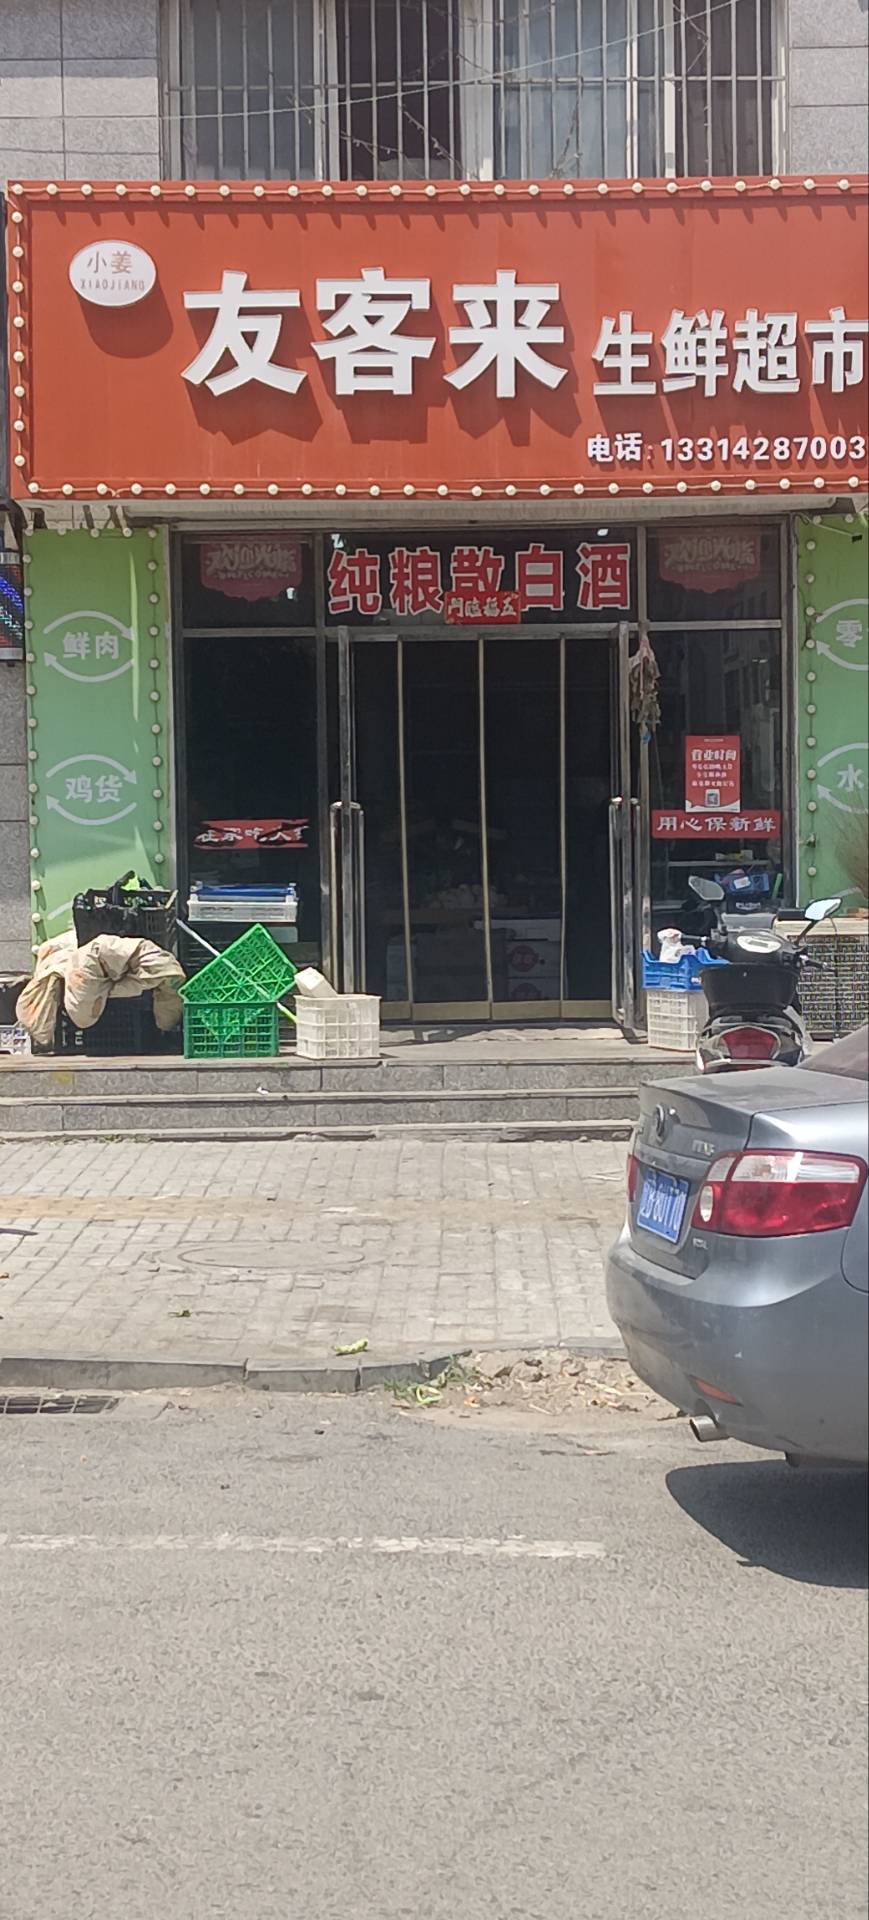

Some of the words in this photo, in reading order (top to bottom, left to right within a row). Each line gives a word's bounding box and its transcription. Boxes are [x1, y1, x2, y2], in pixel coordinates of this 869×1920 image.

[87, 251, 132, 274] 小姜
[181, 266, 569, 398] 友客来
[592, 306, 869, 397] 生鲜超市
[661, 436, 866, 461] 13314287003
[328, 543, 630, 615] 纯粮散白酒
[62, 631, 119, 660] 鲜肉
[691, 749, 737, 761] 营业时间
[65, 775, 123, 803] 鸡货
[656, 816, 776, 832] 用心保新鲜
